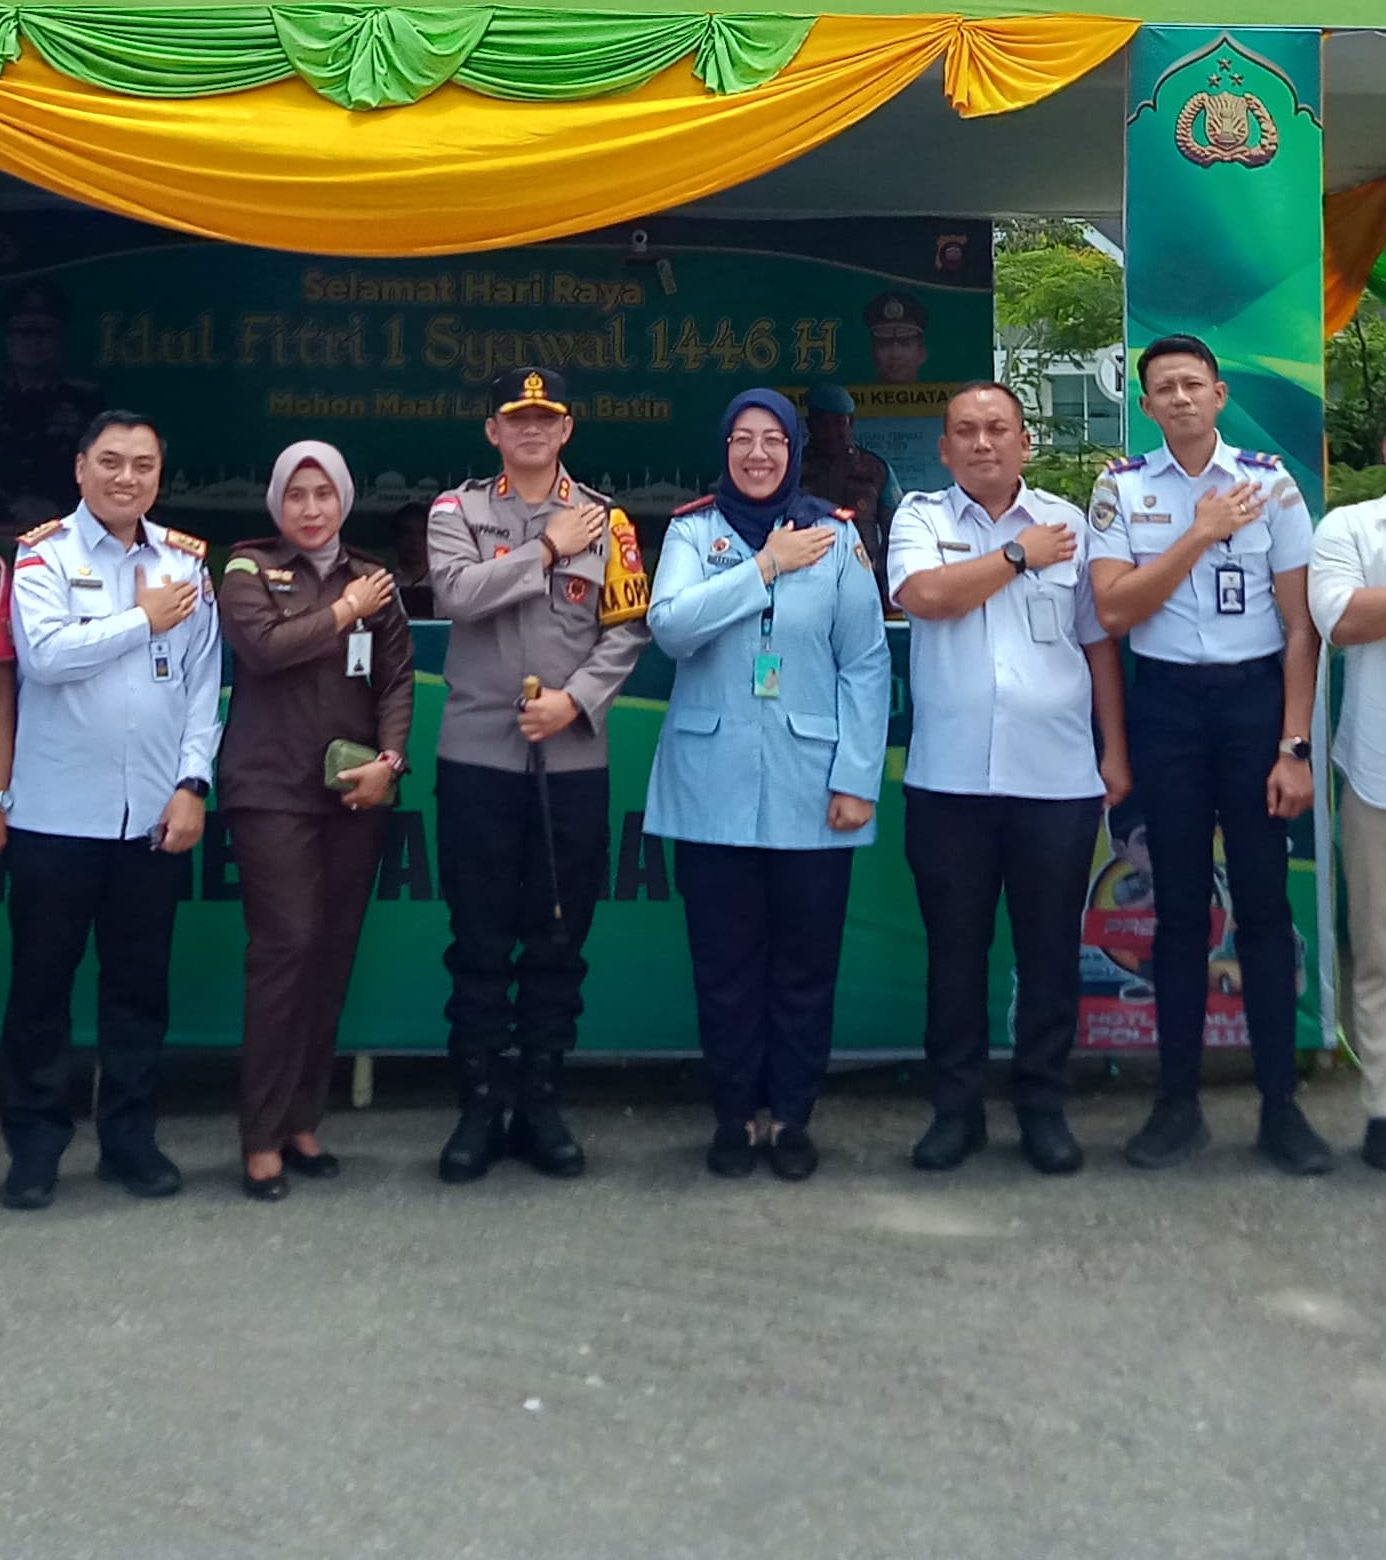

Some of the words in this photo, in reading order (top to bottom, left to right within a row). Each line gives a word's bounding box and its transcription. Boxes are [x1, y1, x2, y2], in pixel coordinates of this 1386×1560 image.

[301, 269, 453, 304] Selamat
[463, 271, 542, 305] Hari
[552, 274, 645, 312] Raya
[95, 307, 223, 368] Idul
[231, 311, 373, 369] Fitri
[381, 313, 406, 369] 1
[423, 313, 642, 382] Syawal
[647, 319, 781, 373] 1446
[793, 318, 842, 373] H
[267, 391, 366, 418] Mohon
[374, 391, 445, 418] Maaf
[592, 393, 671, 421] Batin
[870, 389, 952, 404] KEGIATA
